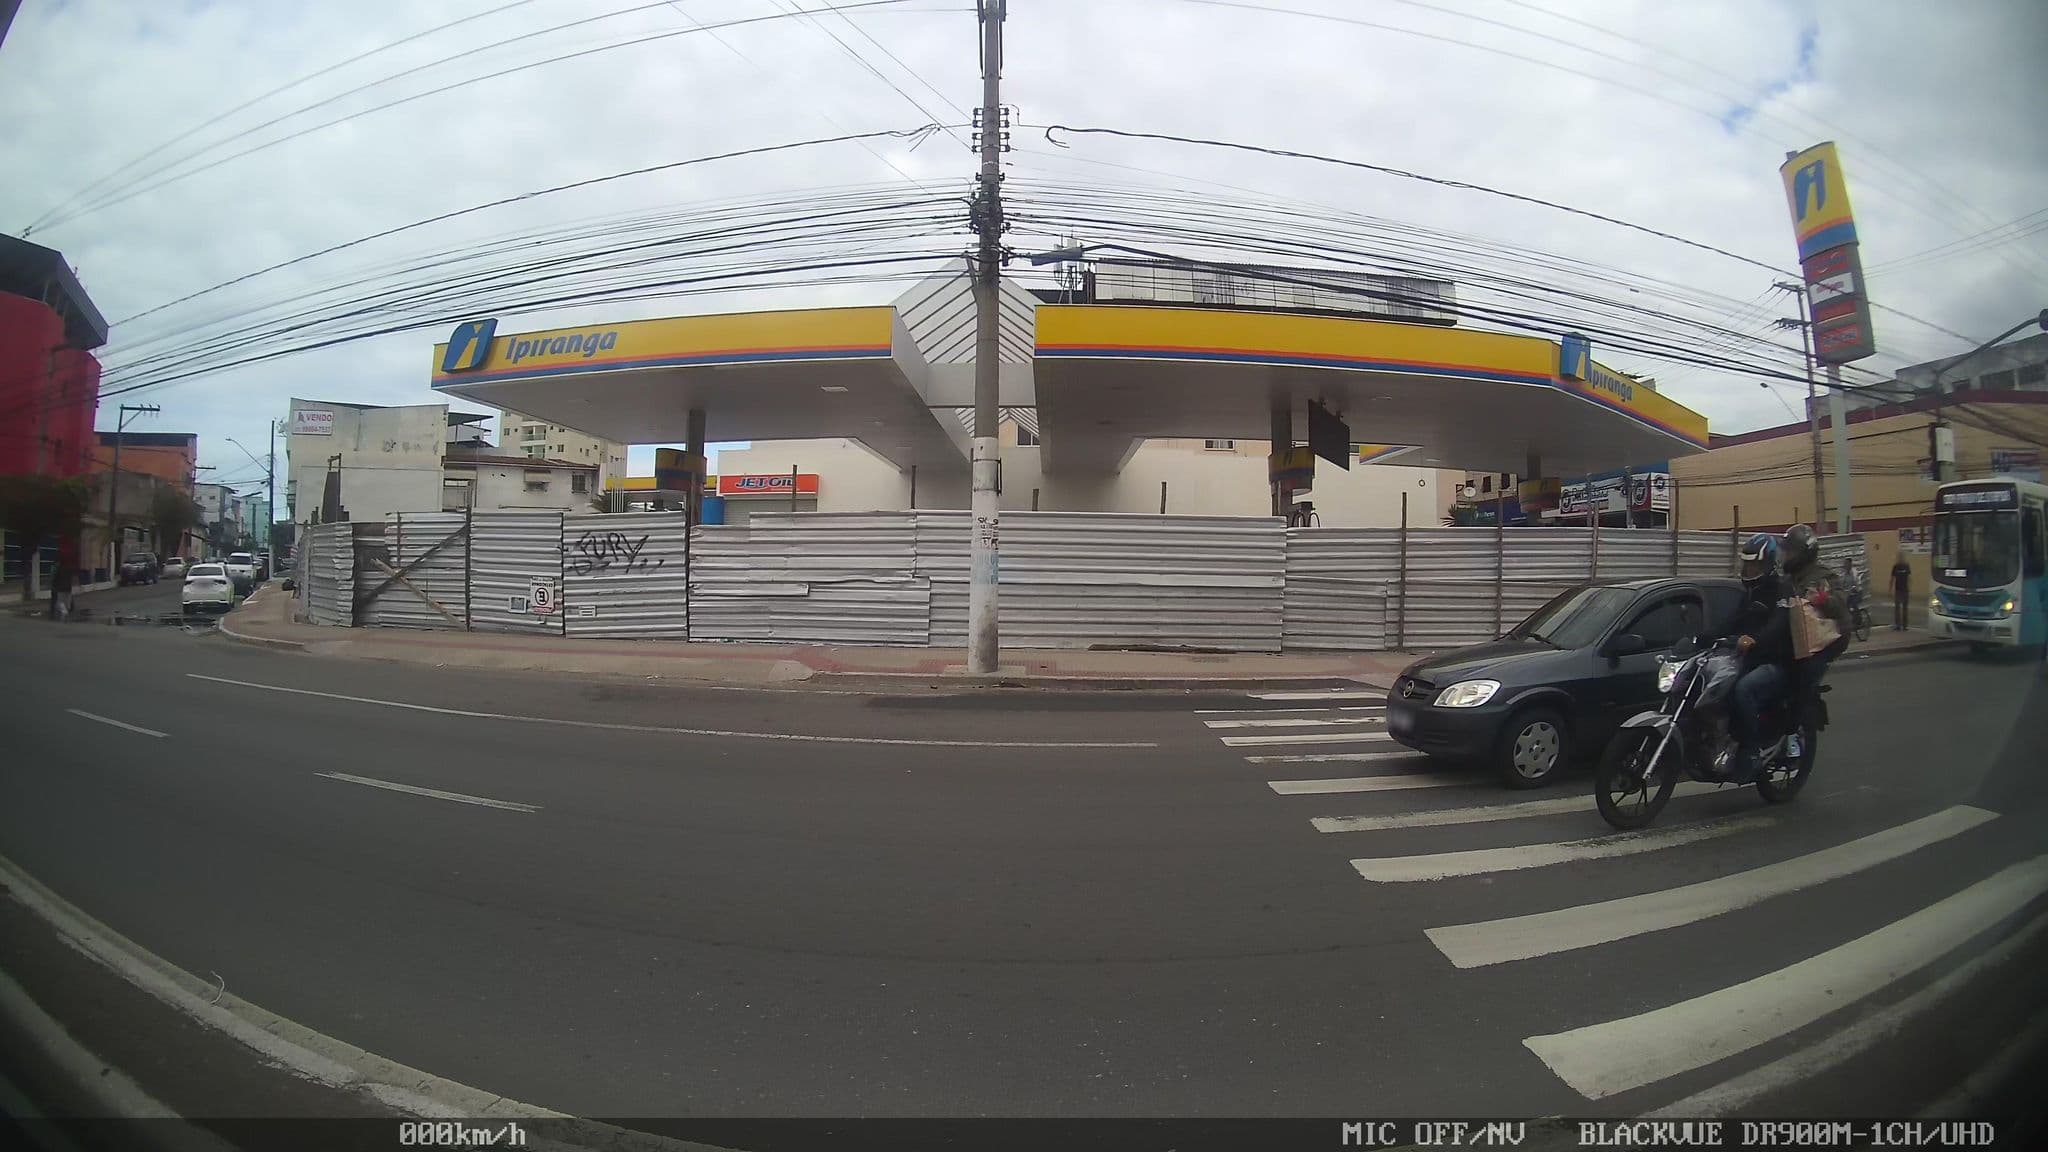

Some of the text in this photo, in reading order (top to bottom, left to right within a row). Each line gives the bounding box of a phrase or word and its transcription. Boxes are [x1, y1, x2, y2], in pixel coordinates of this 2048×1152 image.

[505, 330, 618, 364] Ipiranga
[1590, 369, 1633, 402] piranga
[305, 413, 333, 422] VENDO
[735, 476, 768, 489] JET
